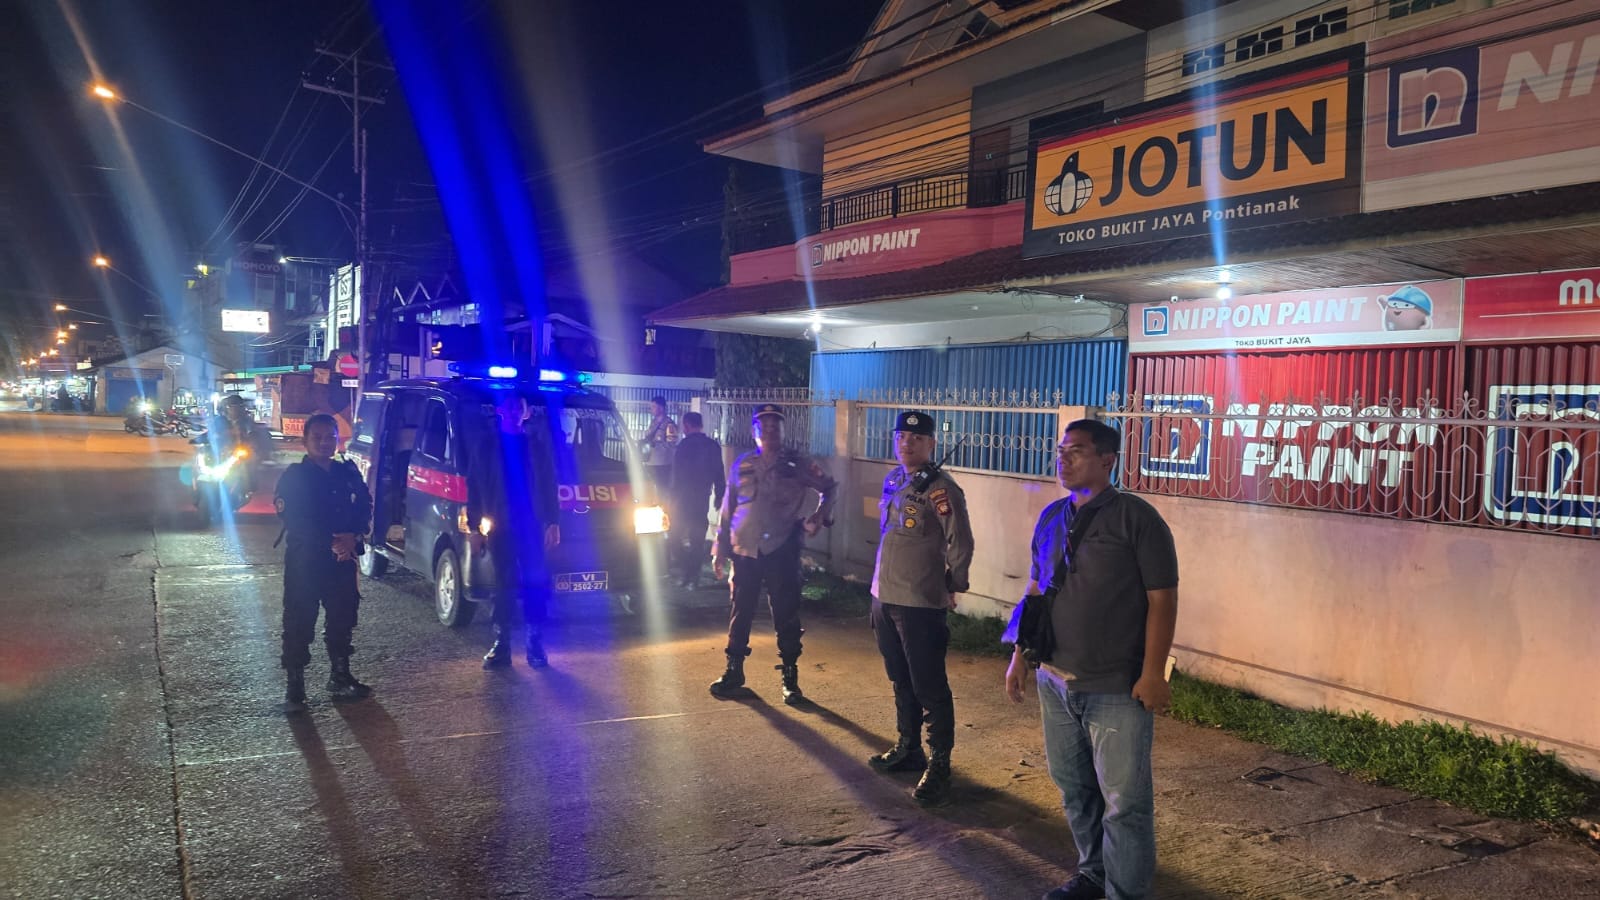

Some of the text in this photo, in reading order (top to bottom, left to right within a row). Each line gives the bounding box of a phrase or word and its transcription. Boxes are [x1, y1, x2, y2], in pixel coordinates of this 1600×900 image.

[1099, 98, 1328, 207] JOTUN
[1058, 195, 1301, 245] TOKO BUKIT JAYA Pontianak
[823, 228, 921, 262] NIPPON PAINT
[1559, 278, 1600, 306] m
[1172, 303, 1272, 331] NIPPON
[1276, 296, 1368, 326] PAINT
[1235, 335, 1312, 347] TOKO BUKIT JAYA
[1222, 403, 1441, 446] NIPPON
[1240, 442, 1414, 487] PAINT
[557, 485, 618, 503] OLISI
[581, 573, 596, 581] VI
